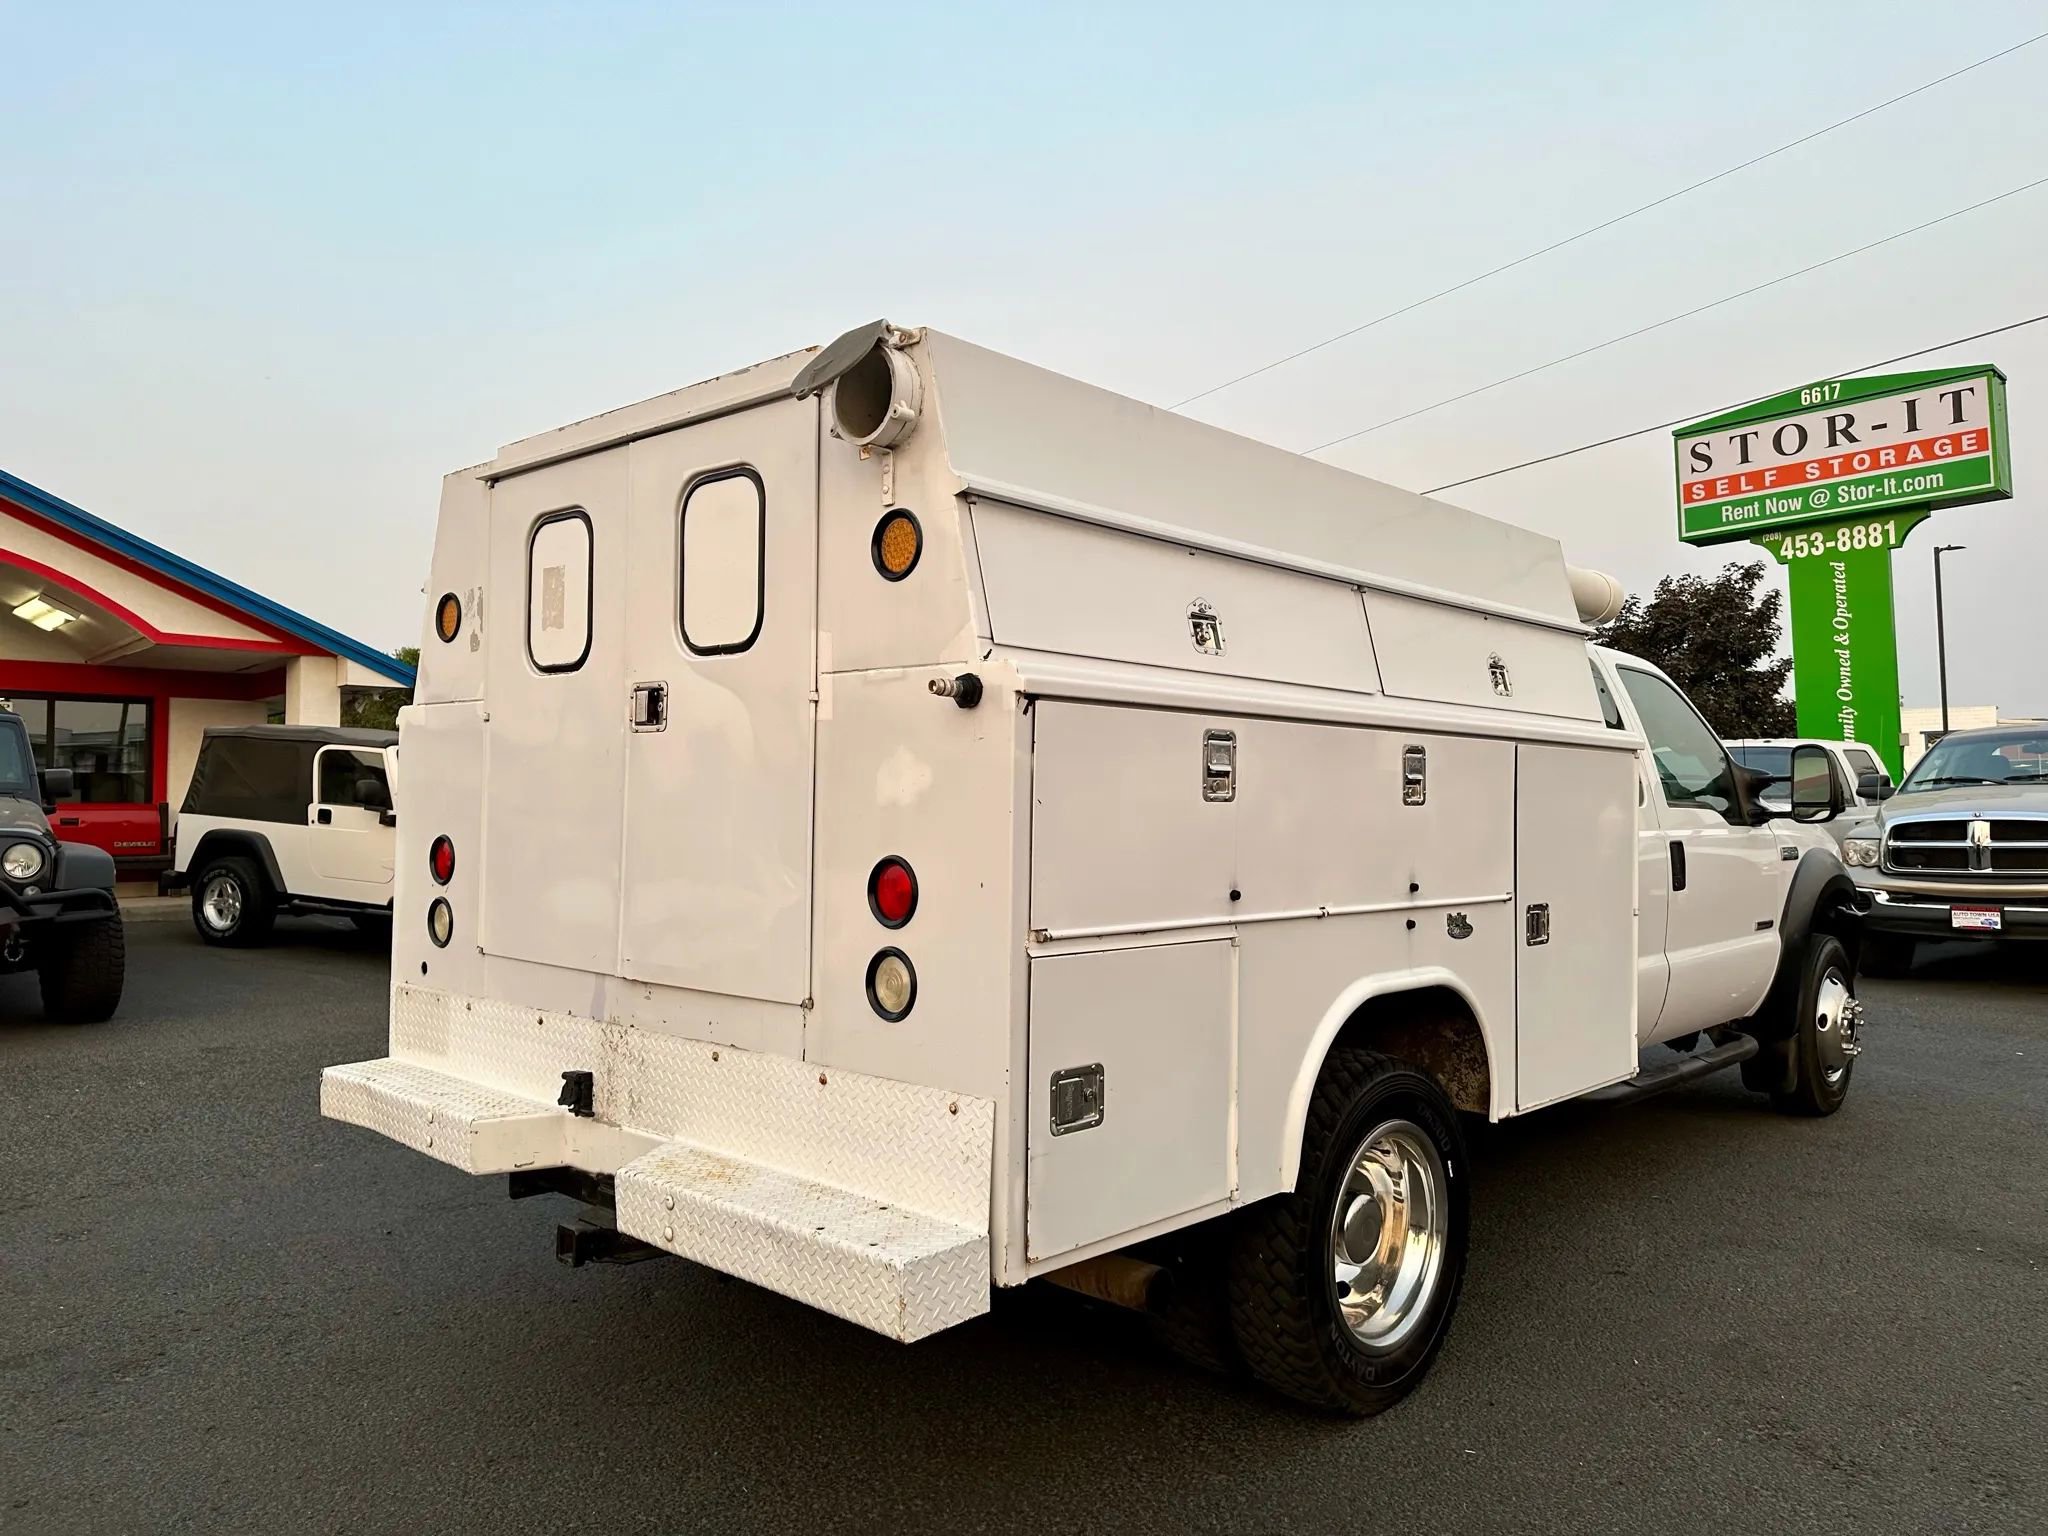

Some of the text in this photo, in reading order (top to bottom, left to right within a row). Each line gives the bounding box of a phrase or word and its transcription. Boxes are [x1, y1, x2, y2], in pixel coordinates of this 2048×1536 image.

[1801, 383, 1841, 406] 6617
[1690, 387, 1975, 474] STOR-IT
[1691, 432, 1978, 500] SELF STORAGE
[1721, 471, 1944, 523] Rent Now @ Stor-It.com
[1780, 521, 1896, 560] 453-8881
[1830, 561, 1853, 630] Operated
[1833, 632, 1850, 646] &
[1836, 649, 1853, 702] Owned
